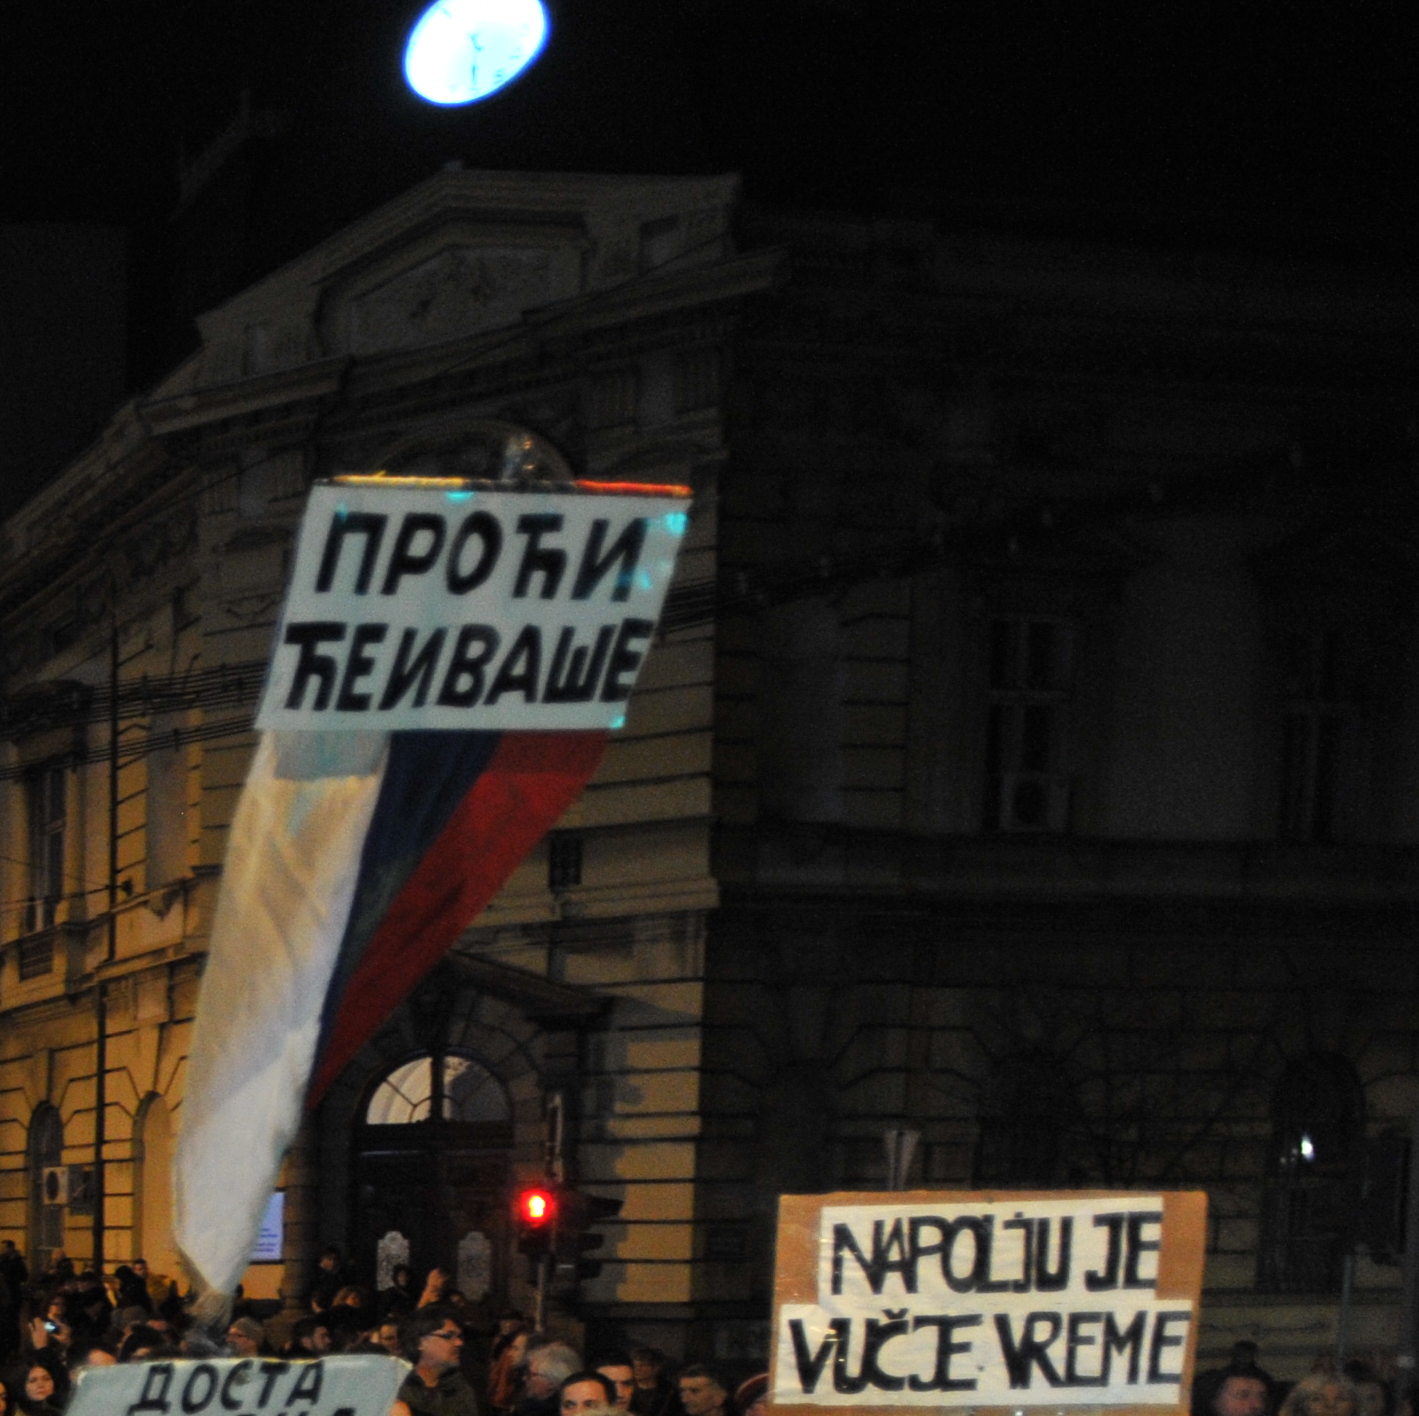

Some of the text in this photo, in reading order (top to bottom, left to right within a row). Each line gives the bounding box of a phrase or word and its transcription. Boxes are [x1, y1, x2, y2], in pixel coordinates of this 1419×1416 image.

[313, 510, 651, 602] ПРОЋИ
[1084, 1210, 1162, 1292] JE
[789, 1308, 1192, 1394] VUČJE VREME
